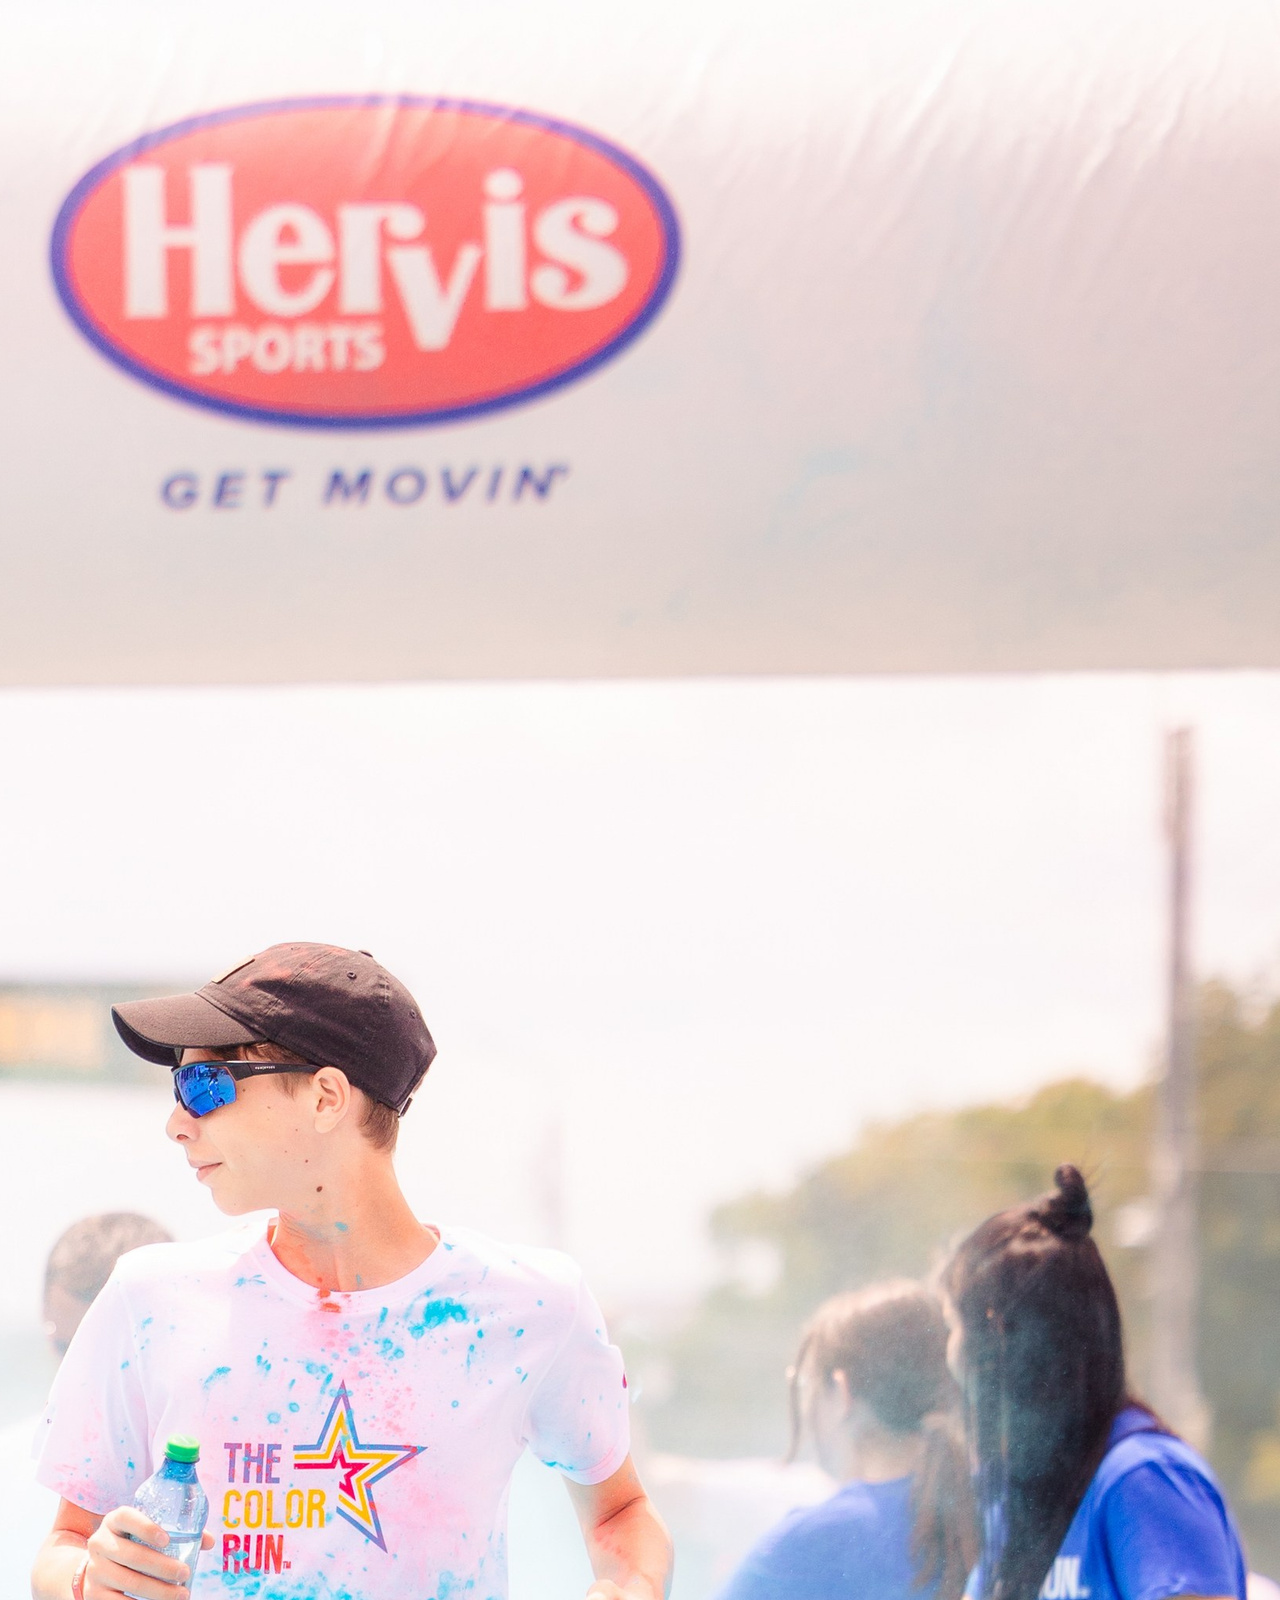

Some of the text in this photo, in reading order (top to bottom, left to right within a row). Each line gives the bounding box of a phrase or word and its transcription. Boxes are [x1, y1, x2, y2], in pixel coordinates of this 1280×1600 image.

[124, 162, 630, 351] Hervis
[189, 323, 386, 375] SPORTS
[159, 470, 291, 512] GET
[223, 1442, 282, 1484] THE
[222, 1489, 327, 1529] COLOR
[222, 1533, 284, 1575] RUN
